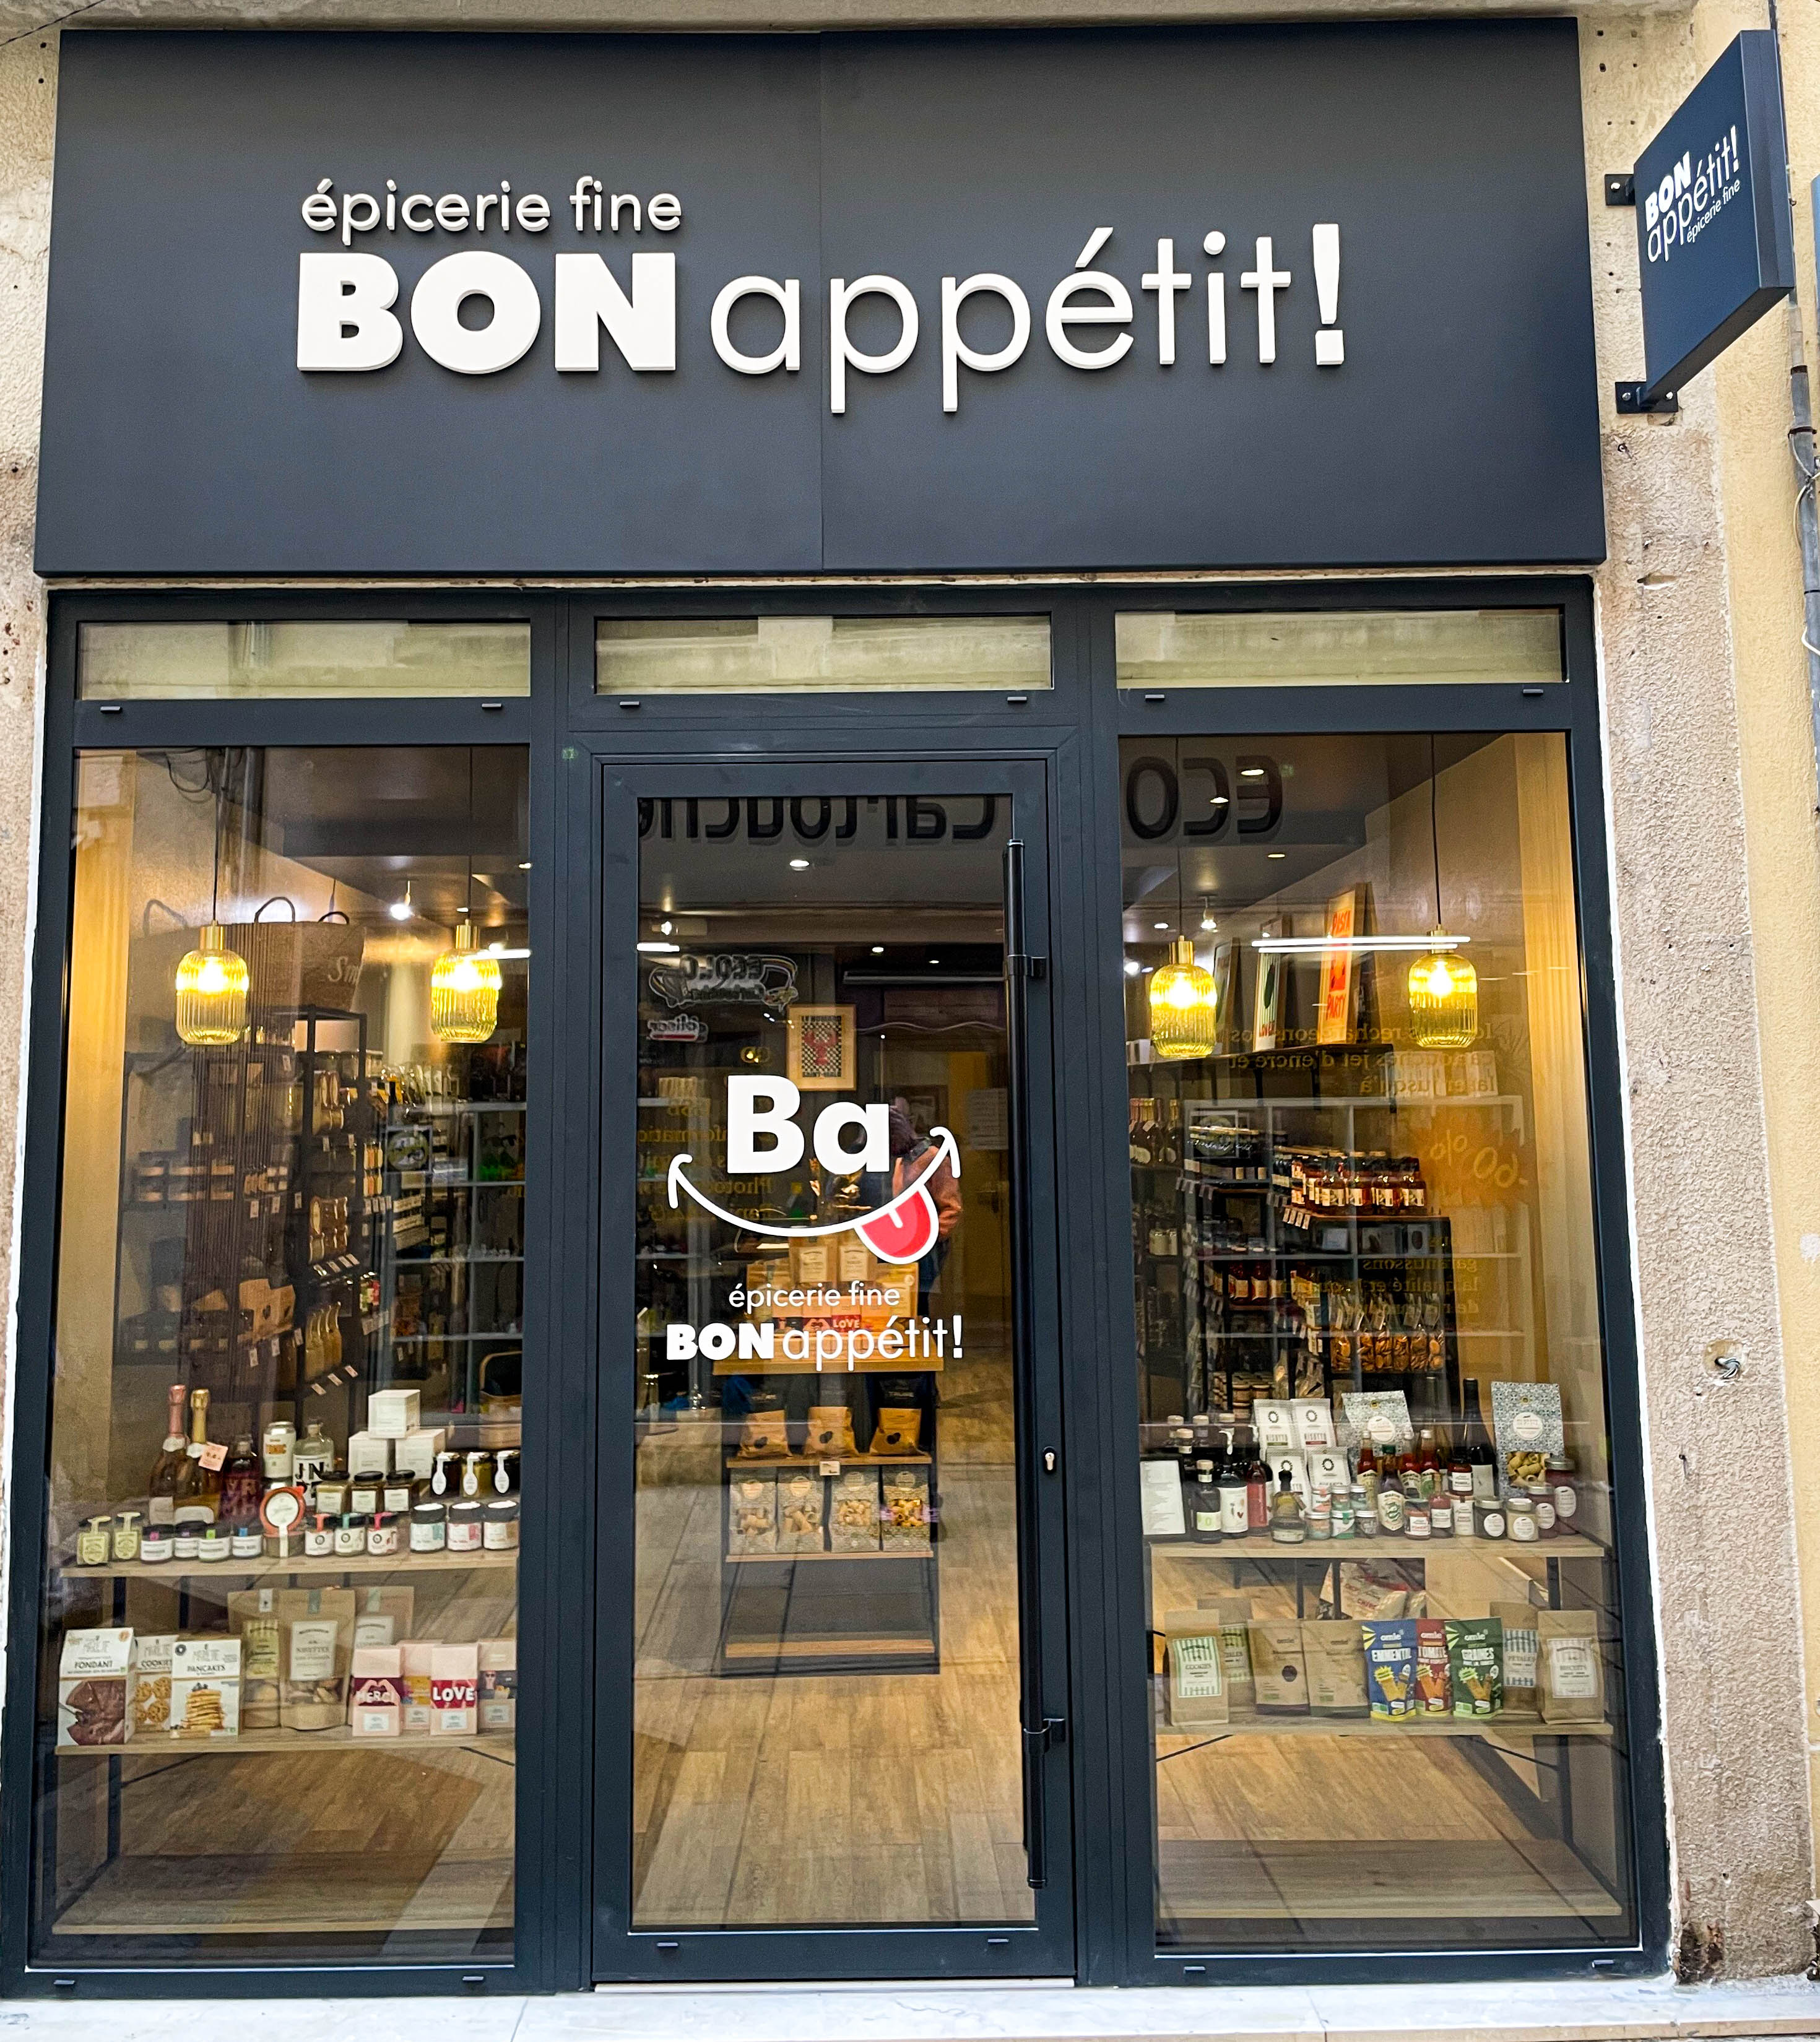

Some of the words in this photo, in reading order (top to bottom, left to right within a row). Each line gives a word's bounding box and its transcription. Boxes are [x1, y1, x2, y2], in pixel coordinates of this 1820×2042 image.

[301, 178, 551, 246] épicerie
[570, 176, 682, 231] fine
[1645, 151, 1691, 231] BON
[1647, 125, 1739, 262] appétit!
[1687, 201, 1721, 243] épicerie
[1723, 179, 1740, 205] fine
[297, 251, 675, 374] BON
[711, 223, 1344, 413] appétit!
[727, 1075, 890, 1175] Ba
[729, 1283, 841, 1314] épicerie
[849, 1281, 900, 1306] fine
[833, 1318, 860, 1328] LOVE
[666, 1322, 774, 1361] BON
[782, 1315, 963, 1372] appétit!
[74, 1659, 113, 1669] FONDANT
[141, 1659, 172, 1668] COOKIE
[356, 1691, 396, 1703] MERCI
[432, 1687, 475, 1702] LOVE
